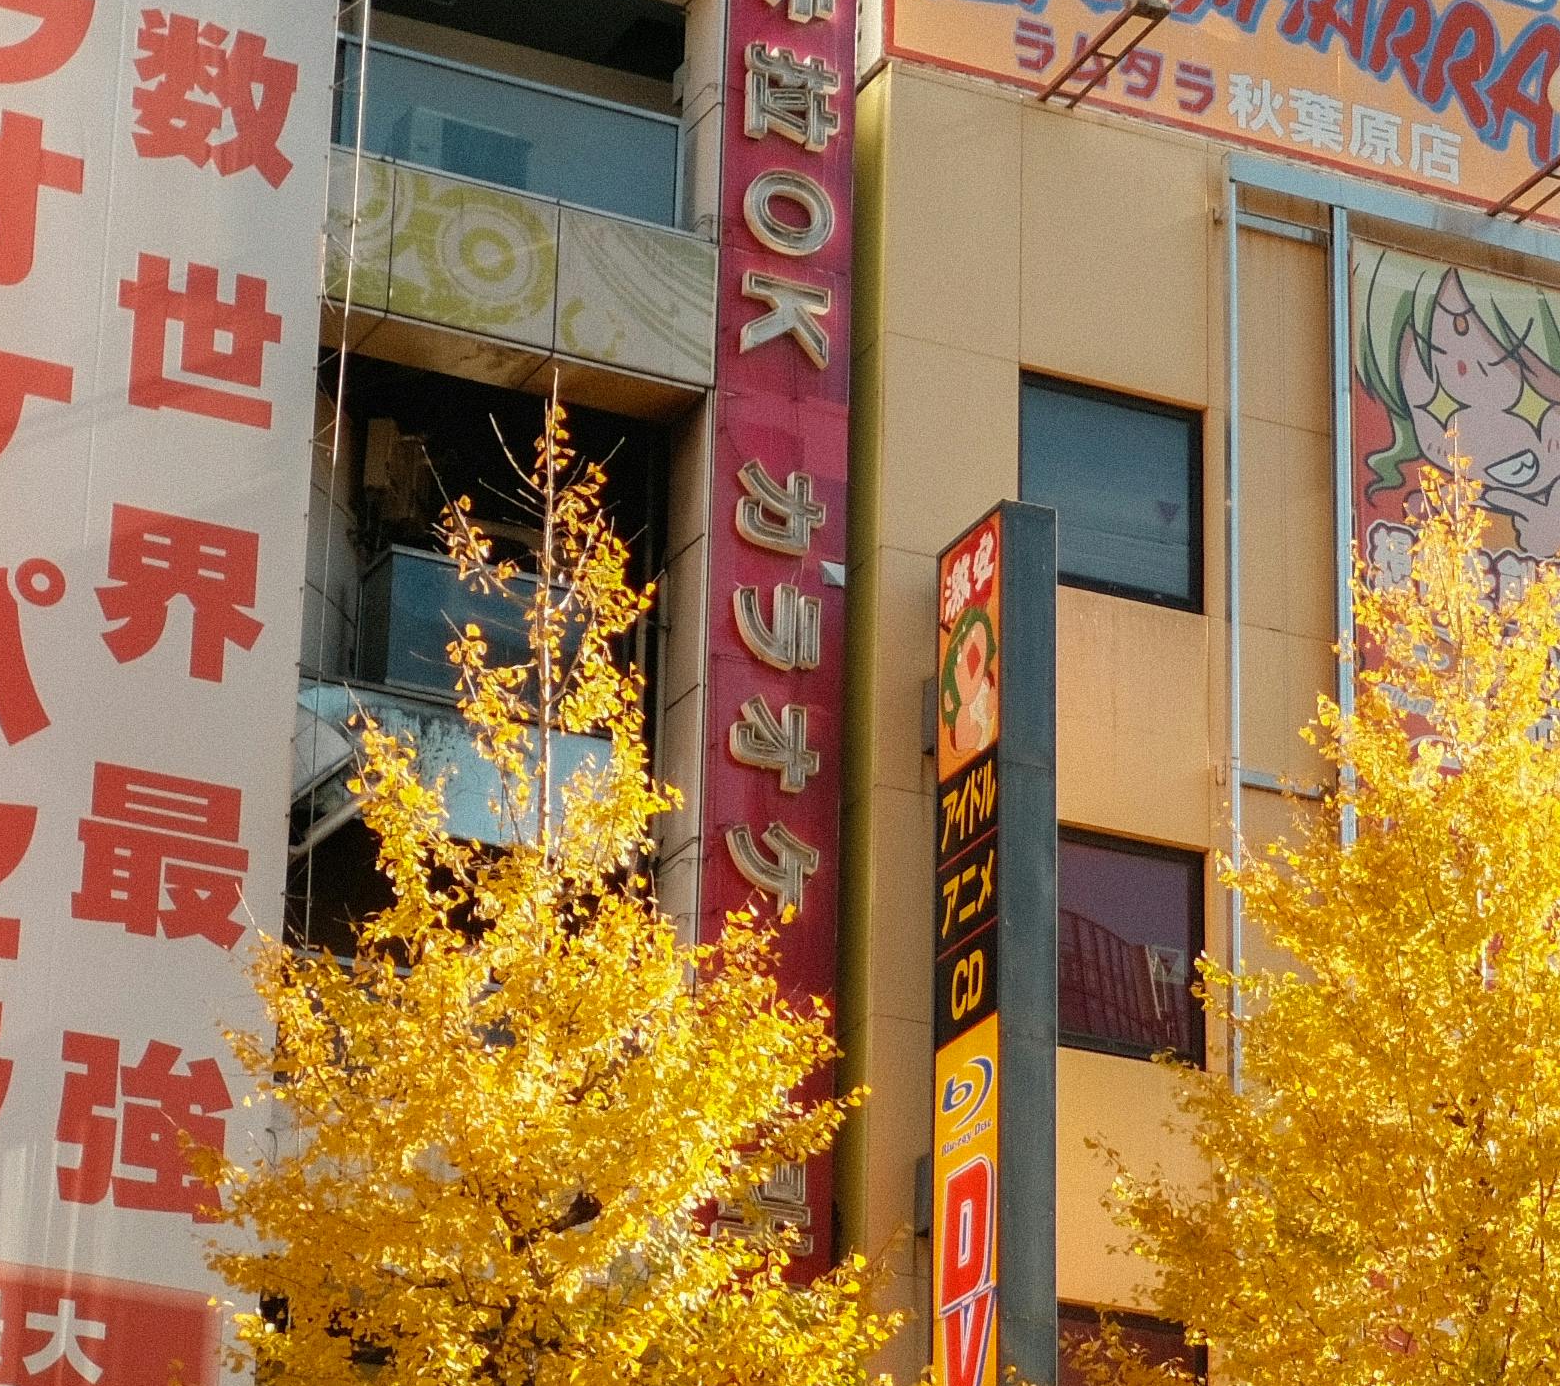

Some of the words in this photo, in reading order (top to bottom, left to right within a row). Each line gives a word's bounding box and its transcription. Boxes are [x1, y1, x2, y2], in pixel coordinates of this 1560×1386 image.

[1227, 72, 1463, 187] 秋葉原店
[944, 529, 997, 625] 激安
[940, 756, 997, 855] アイドル
[940, 859, 995, 940] アニメ
[950, 947, 985, 1023] CD
